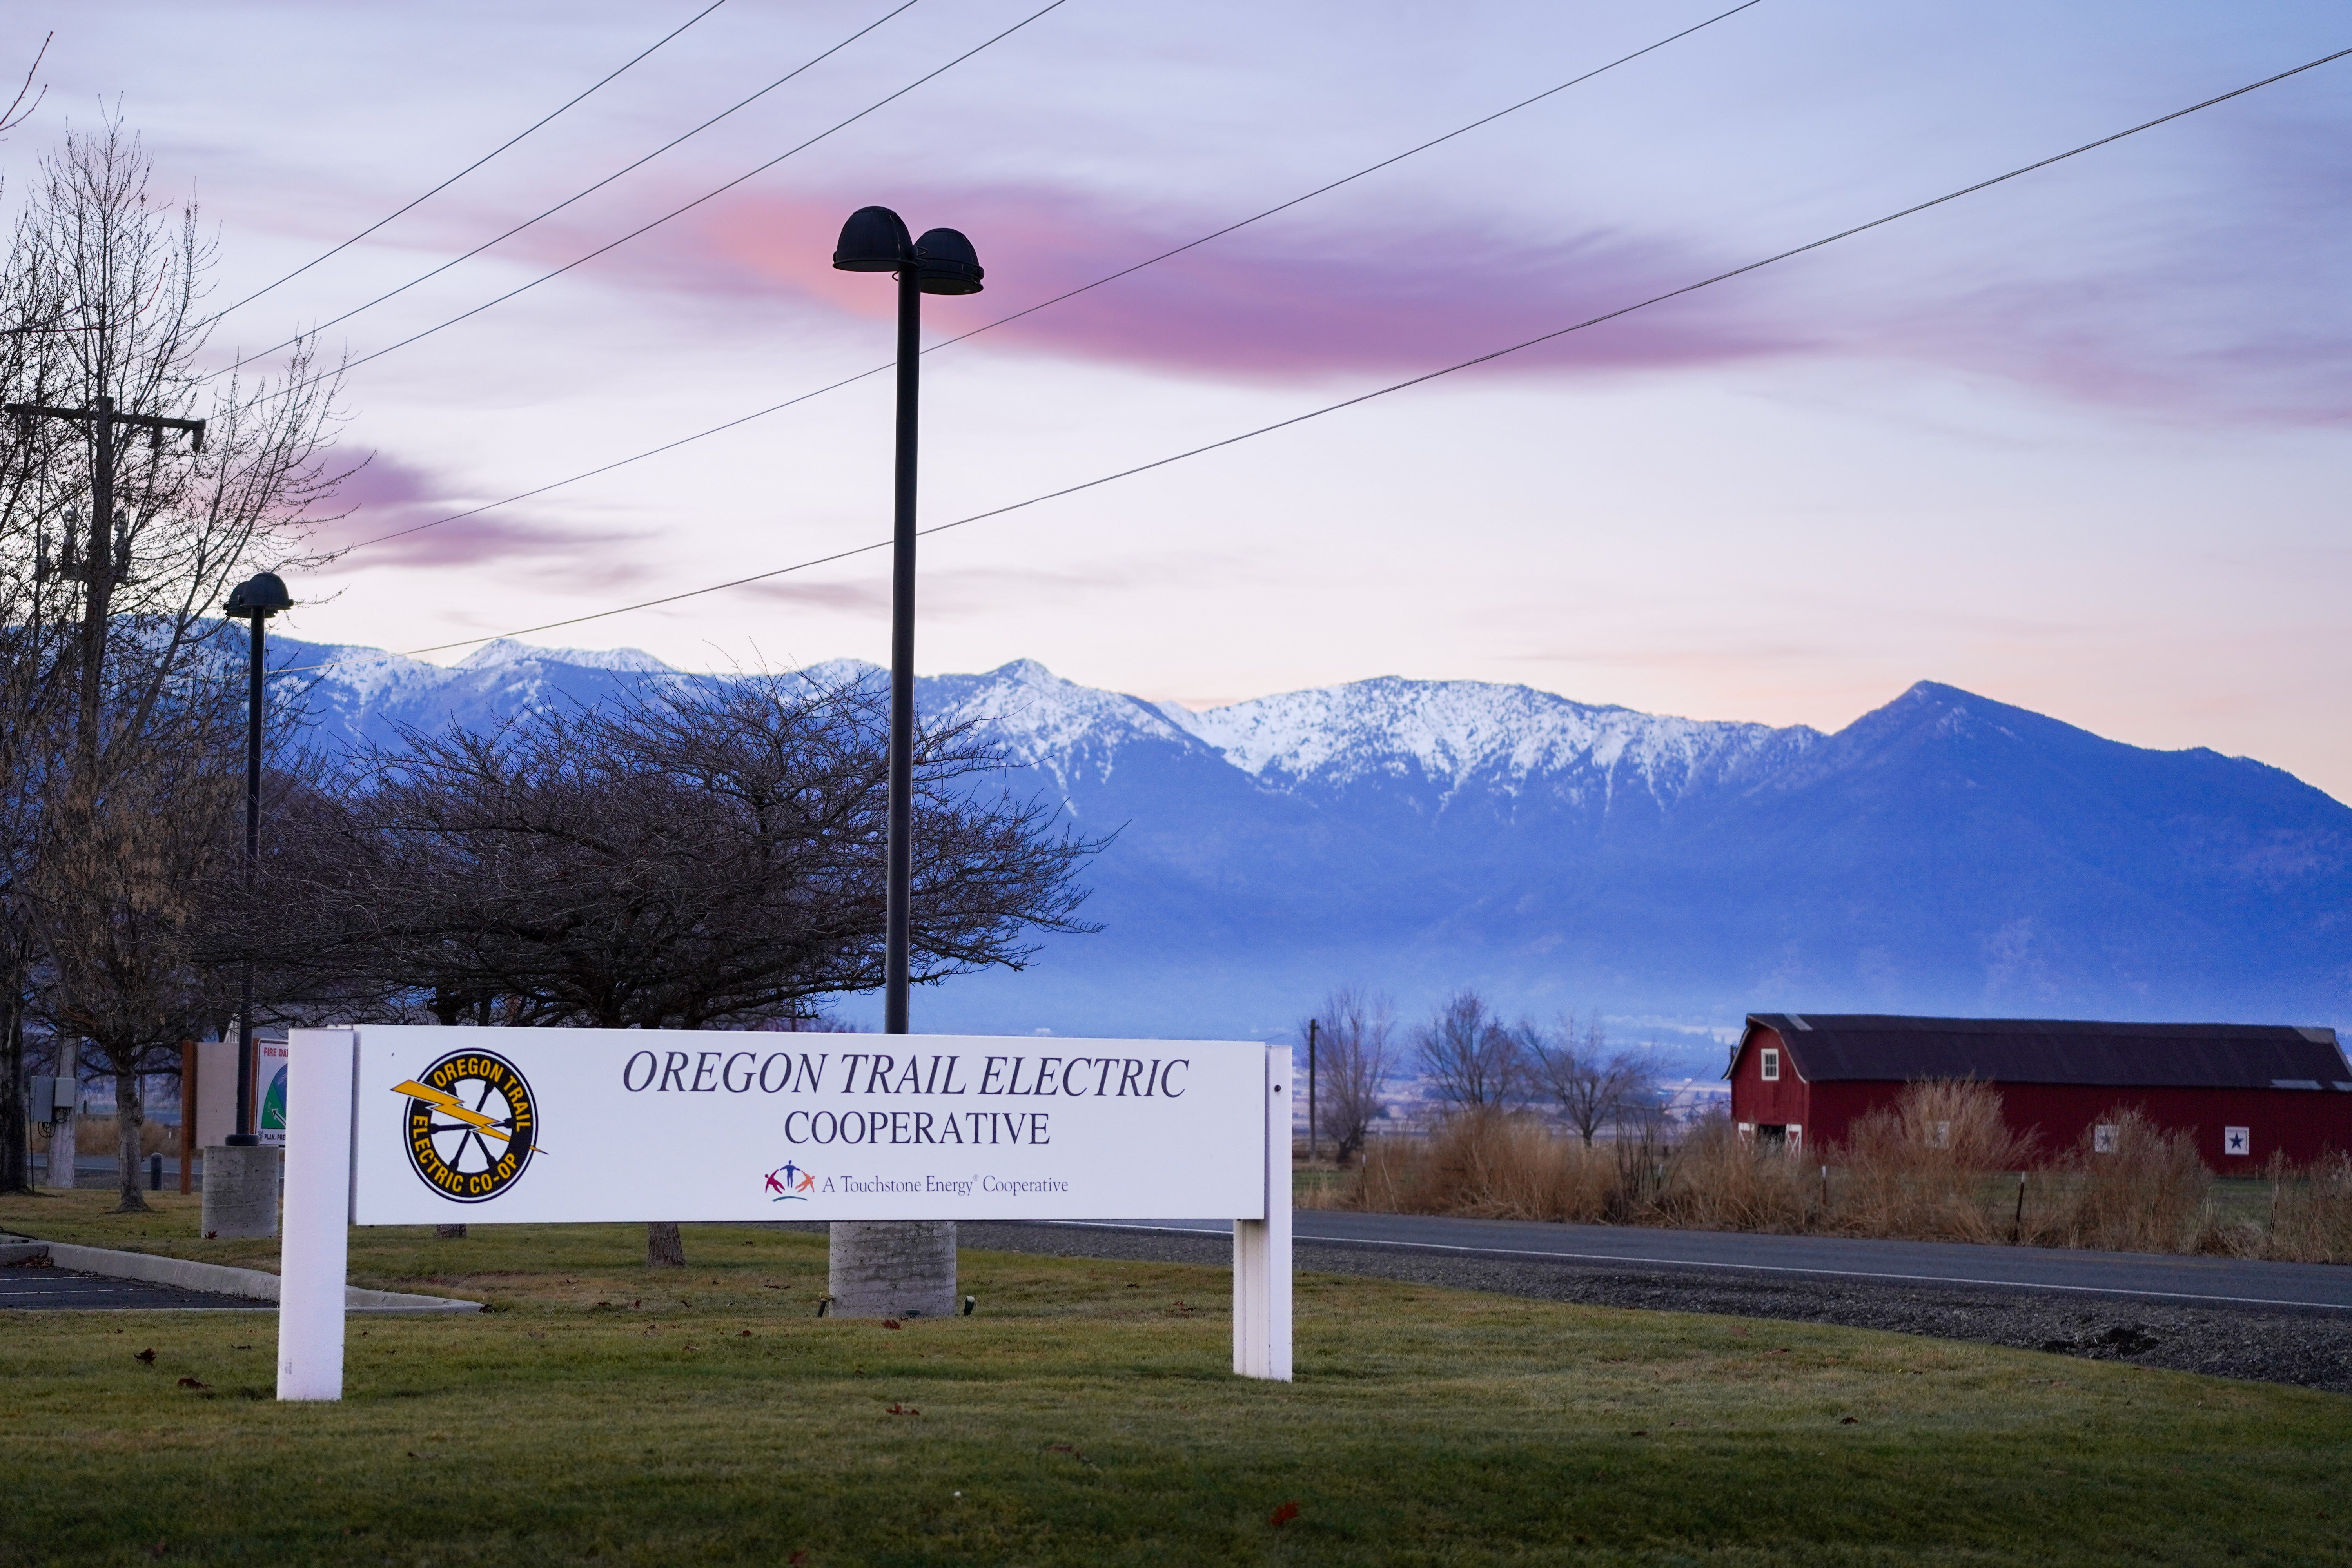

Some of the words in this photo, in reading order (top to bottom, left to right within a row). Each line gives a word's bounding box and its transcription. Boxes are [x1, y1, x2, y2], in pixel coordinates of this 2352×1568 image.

[264, 1047, 277, 1056] FIRE
[623, 1050, 829, 1094] OREGON
[840, 1054, 967, 1094] TRAIL
[977, 1056, 1189, 1098] ELECTRIC
[433, 1057, 504, 1088] OREGON
[503, 1075, 531, 1132] TRAIL
[785, 1111, 1050, 1144] COOPERATIVE
[412, 1115, 464, 1192] ELECTRIC
[469, 1152, 517, 1194] CO-OP
[822, 1176, 836, 1192] A
[840, 1175, 922, 1192] Touchstone
[983, 1175, 1068, 1196] Cooperative
